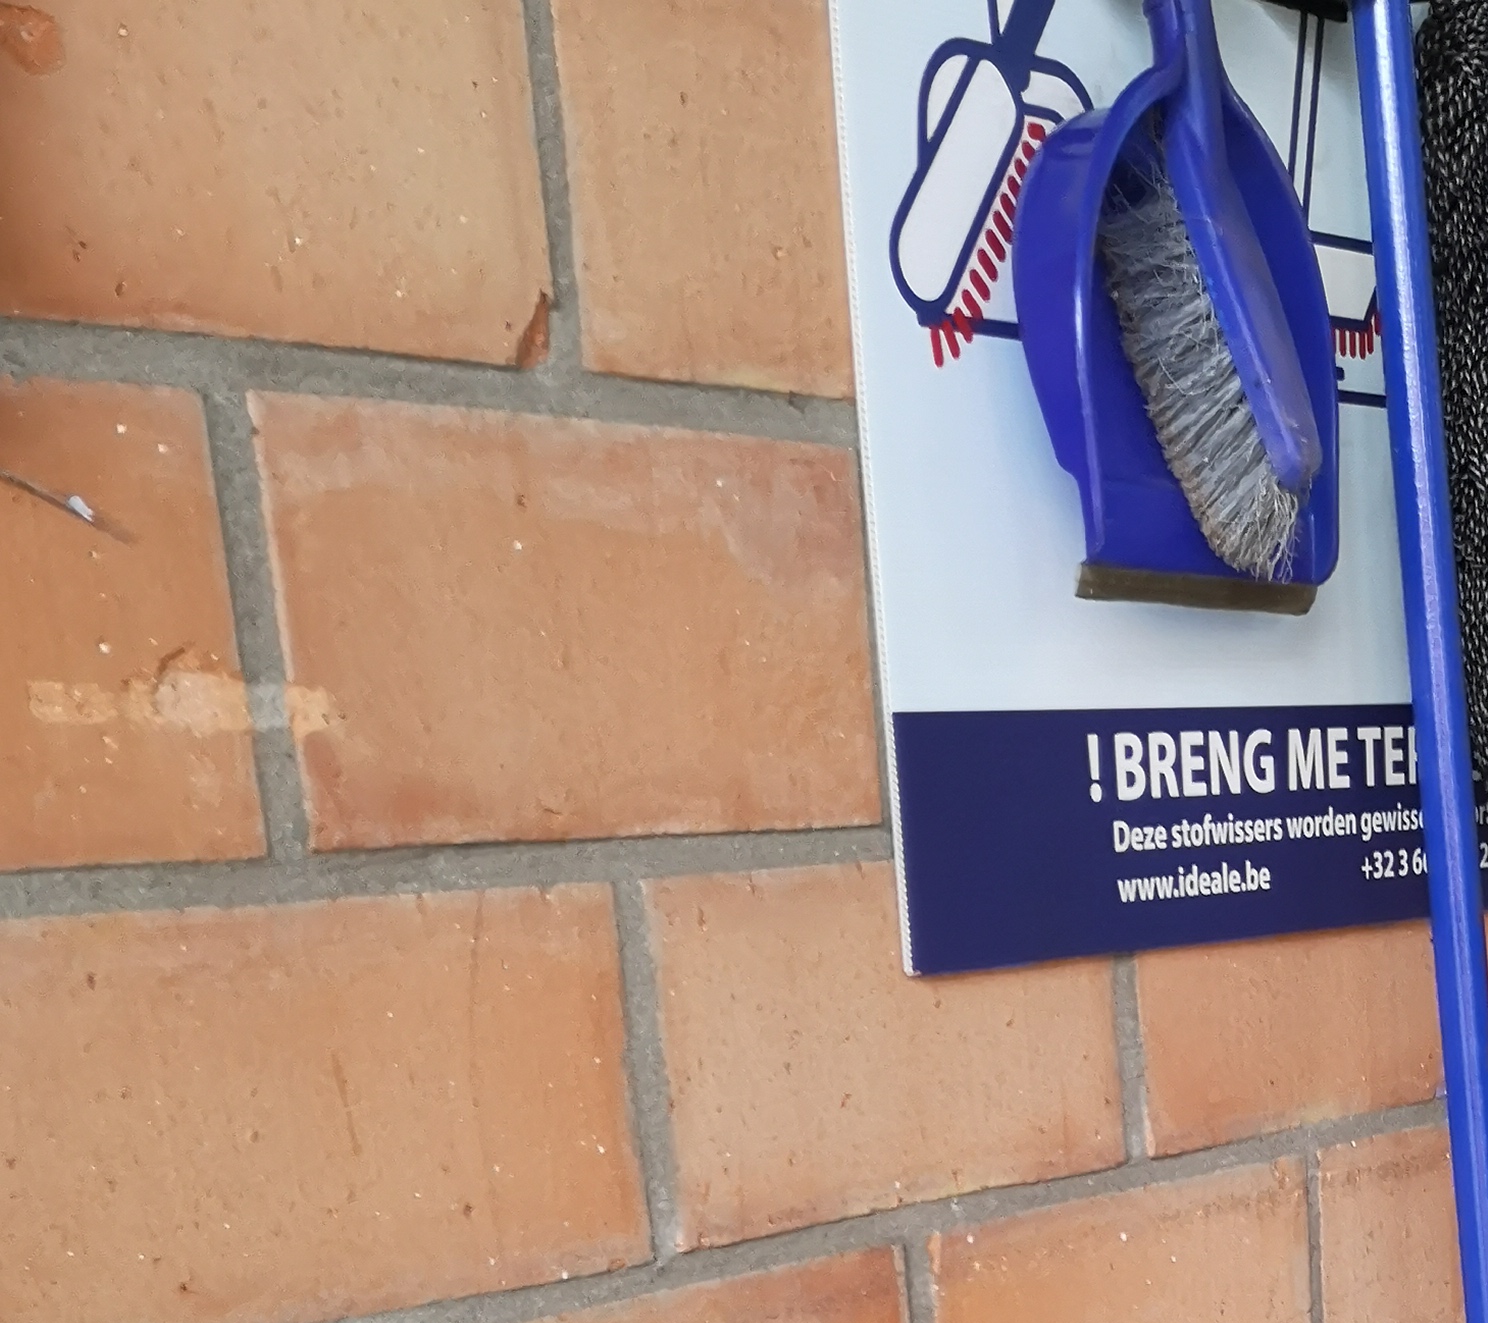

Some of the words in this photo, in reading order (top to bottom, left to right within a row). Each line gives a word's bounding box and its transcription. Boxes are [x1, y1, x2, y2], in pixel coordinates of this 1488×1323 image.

[1087, 733, 1102, 803] !
[1114, 729, 1276, 801] BRENG
[1288, 727, 1351, 791] ME
[1113, 820, 1167, 853] Deze
[1171, 812, 1283, 848] stofwissers
[1286, 806, 1357, 839] worden
[1117, 859, 1271, 903] www.ideale.be
[1361, 849, 1395, 880] +32
[1398, 848, 1409, 876] 3
[1412, 848, 1428, 876] 6
